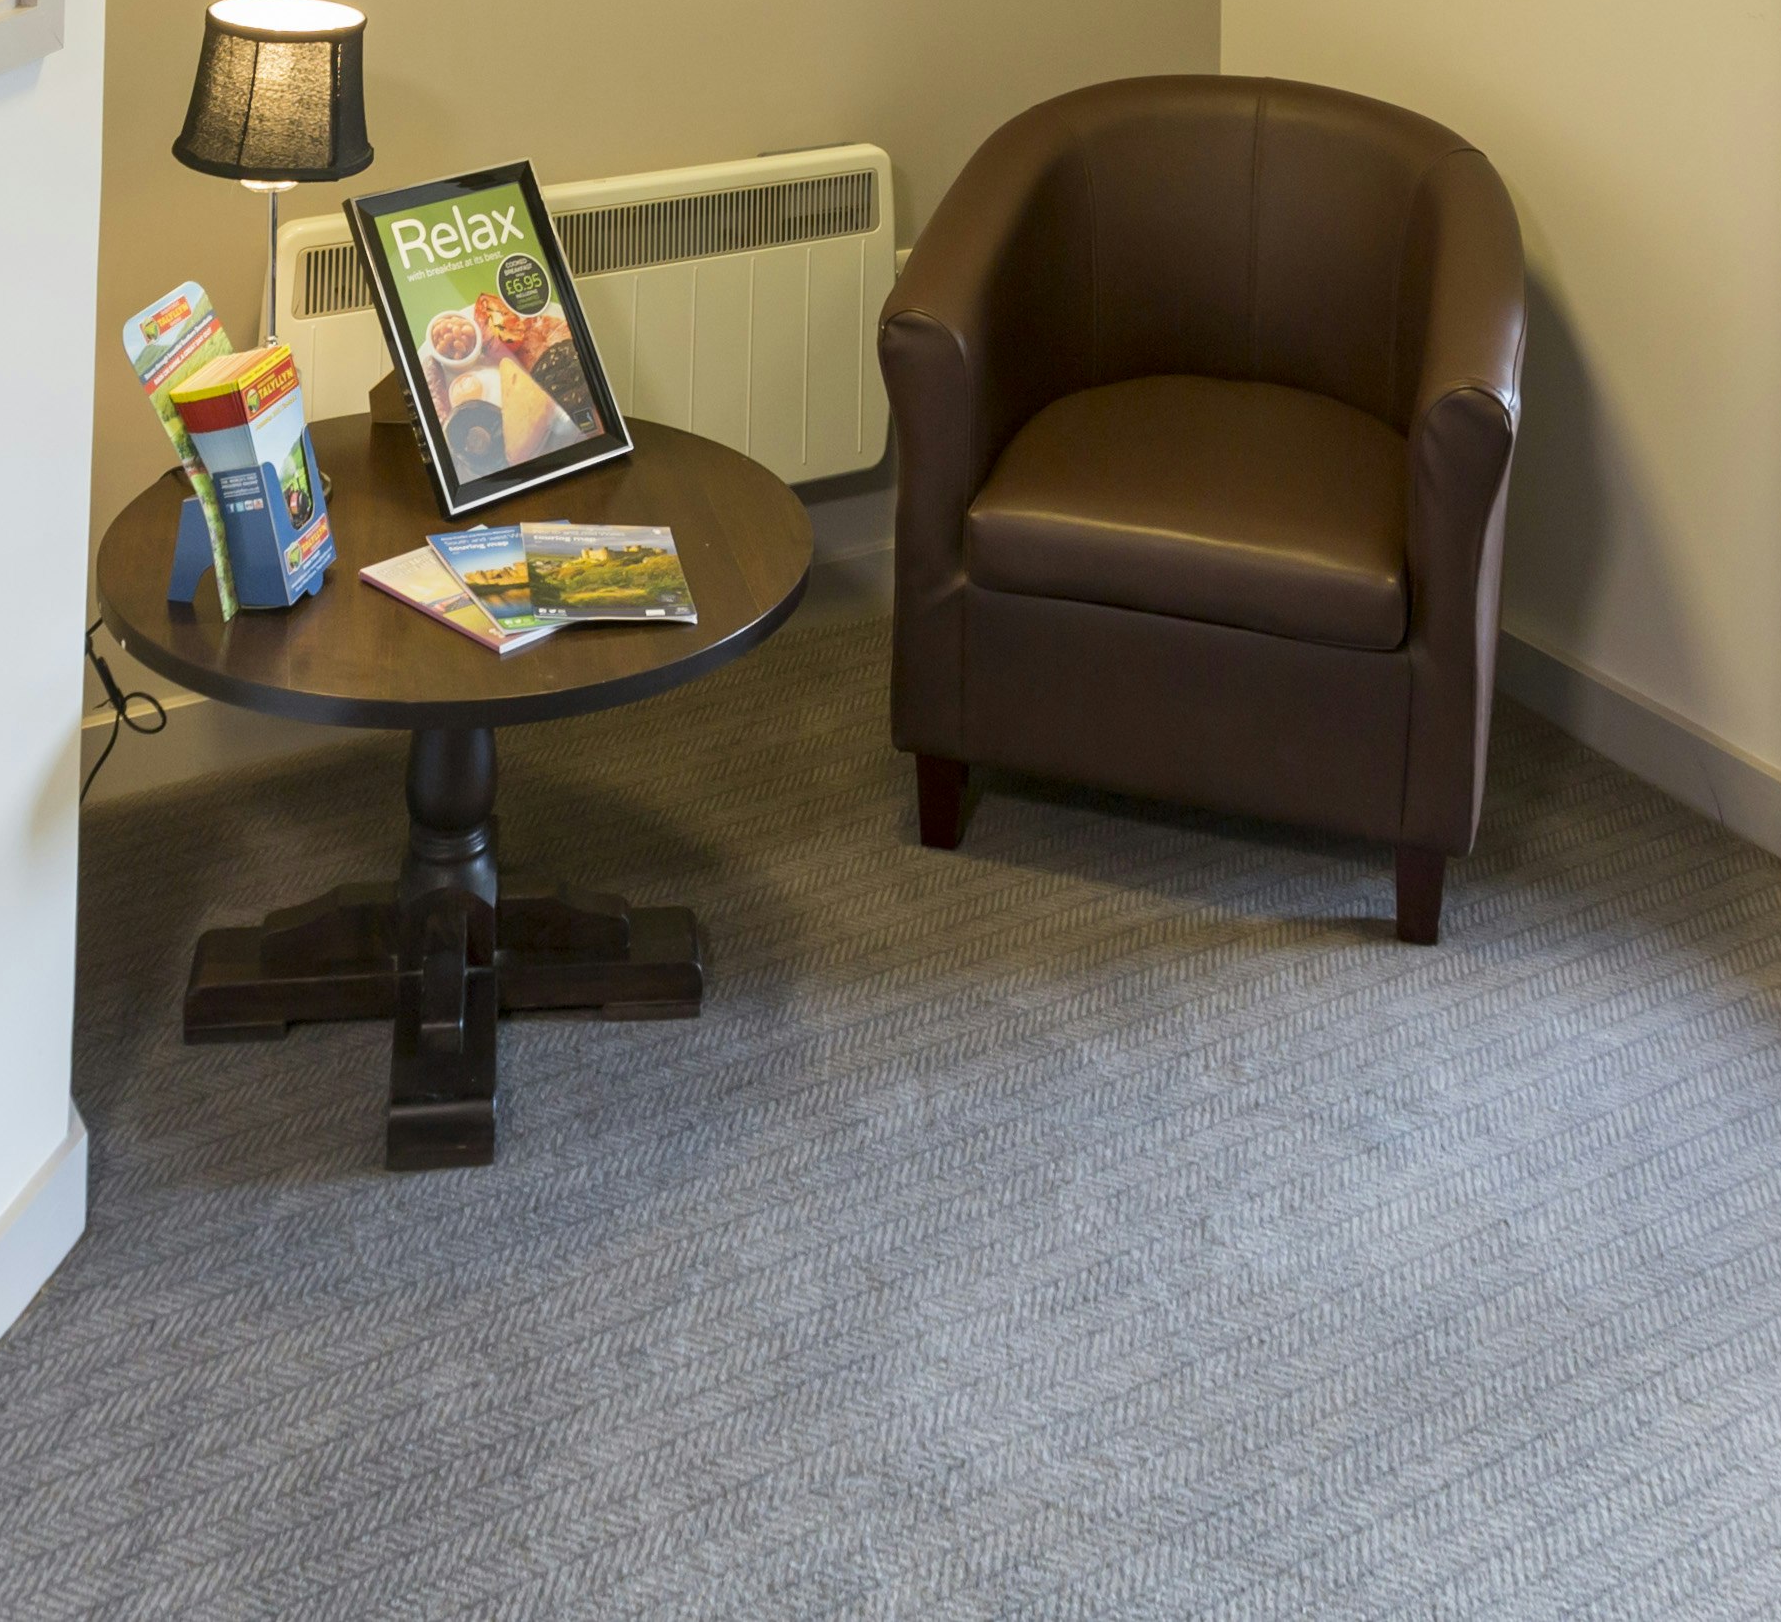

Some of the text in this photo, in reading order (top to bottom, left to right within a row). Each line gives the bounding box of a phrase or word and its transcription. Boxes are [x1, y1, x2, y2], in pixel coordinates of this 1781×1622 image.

[391, 205, 524, 269] Relax
[407, 270, 426, 282] with
[426, 258, 465, 277] breakfast
[505, 273, 542, 295] £6.95
[449, 543, 486, 552] touring
